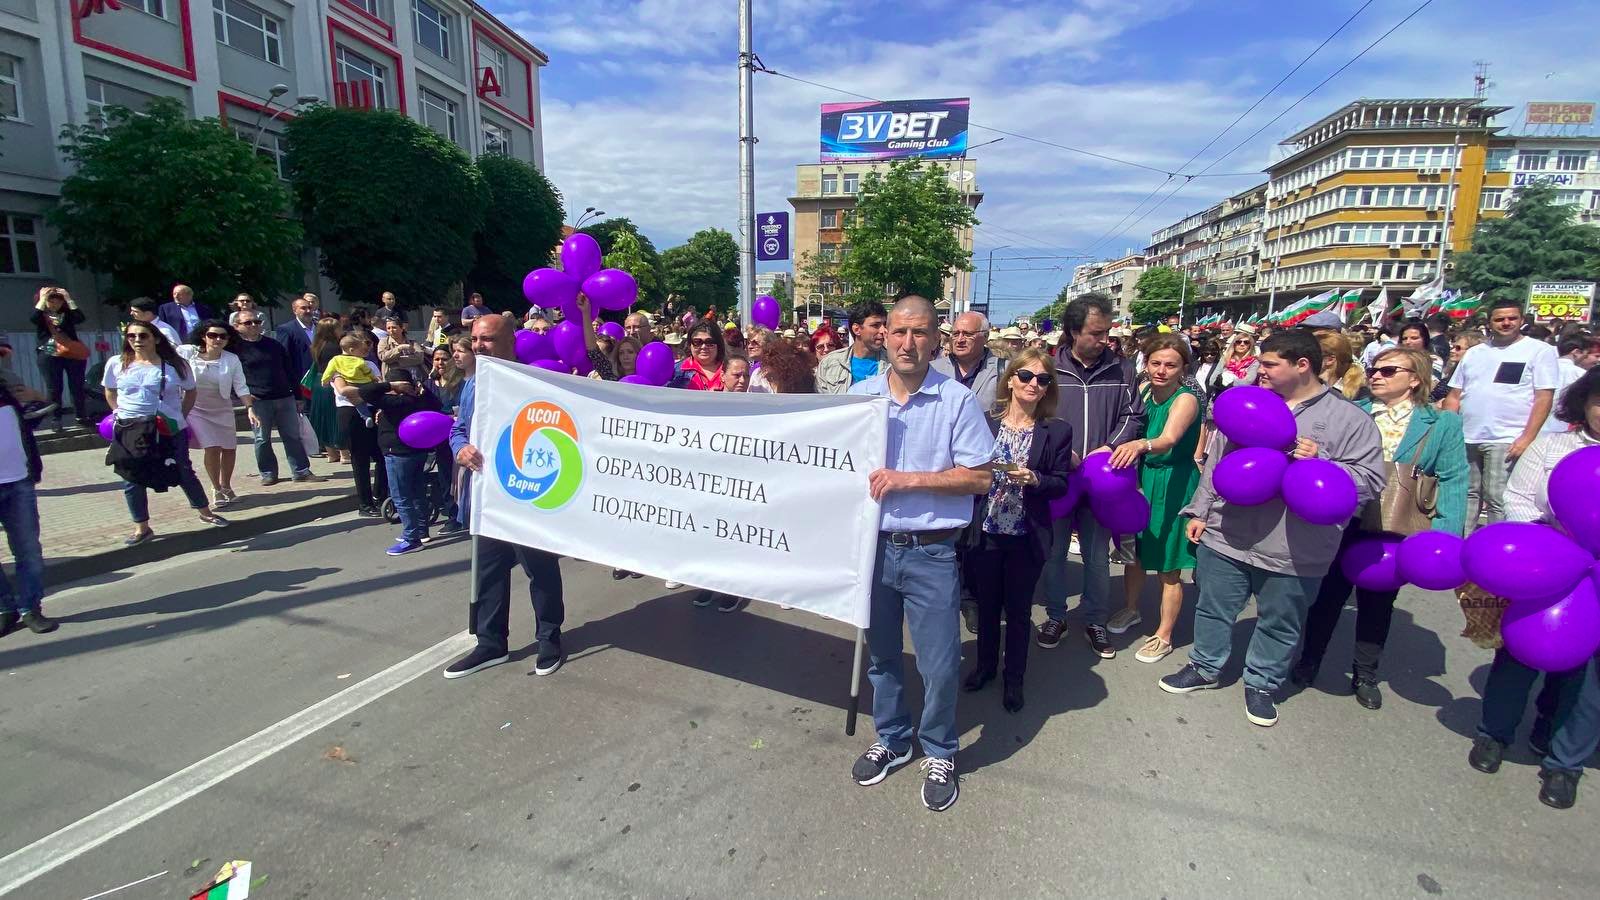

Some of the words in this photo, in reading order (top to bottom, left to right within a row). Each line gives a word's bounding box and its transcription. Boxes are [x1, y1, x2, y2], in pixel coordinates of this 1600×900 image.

[842, 111, 949, 140] 3VBET
[888, 140, 926, 150] Gaming
[927, 138, 949, 147] Club
[527, 408, 561, 424] ЦСОП
[600, 416, 676, 444] ЦЕНТЪР
[679, 427, 703, 450] ЗА
[709, 432, 856, 472] СПЕЦИАЛНА
[507, 474, 541, 493] Варна
[596, 455, 768, 504] ОБРАЗОВАТЕЛНА
[591, 494, 697, 532] ПОДКРЕПА
[715, 518, 791, 552] ВАРНА
